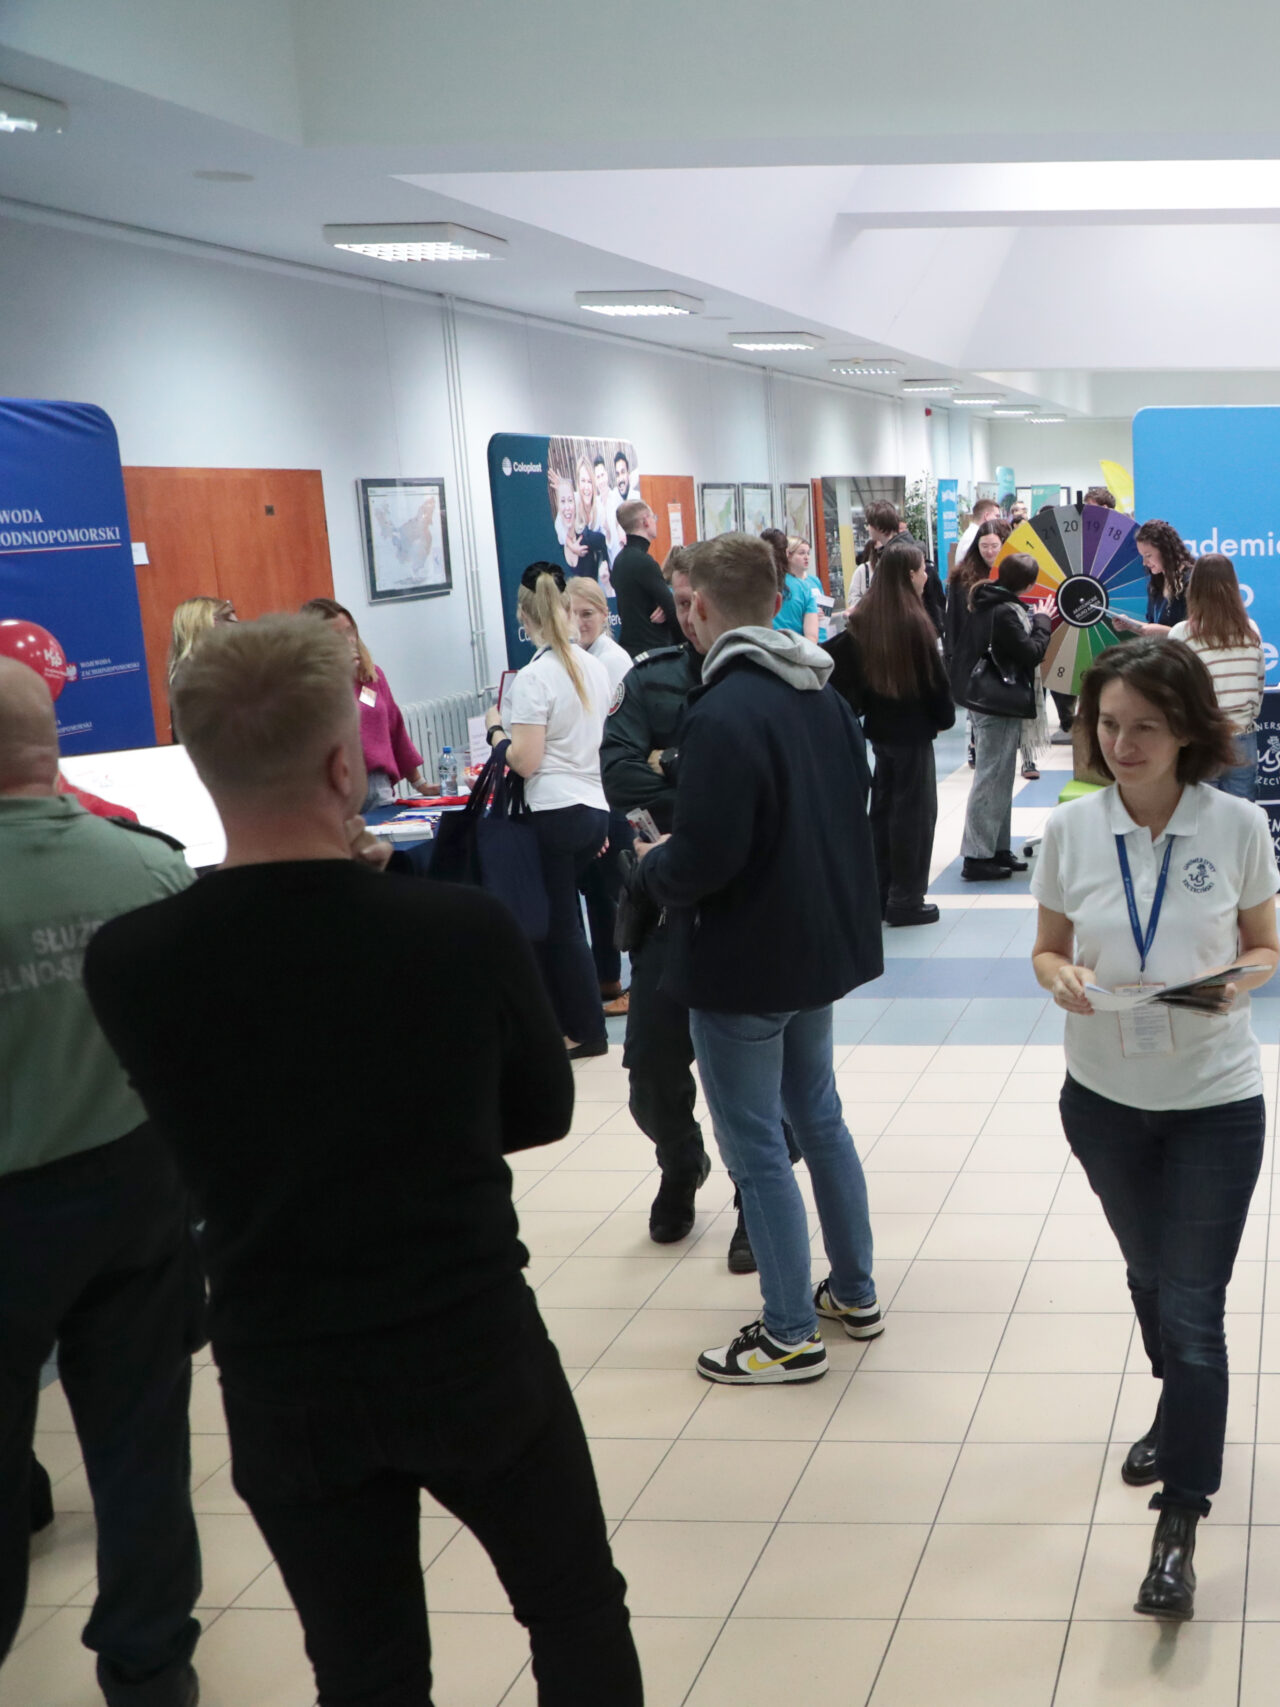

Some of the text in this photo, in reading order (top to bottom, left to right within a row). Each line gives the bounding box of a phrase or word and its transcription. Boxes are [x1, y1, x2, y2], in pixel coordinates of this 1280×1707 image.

[513, 461, 542, 475] Coloplast
[1063, 519, 1079, 533] 20
[0, 526, 121, 547] ODNIOPOMORSKI
[1108, 526, 1122, 541] 18
[1057, 666, 1066, 678] 8
